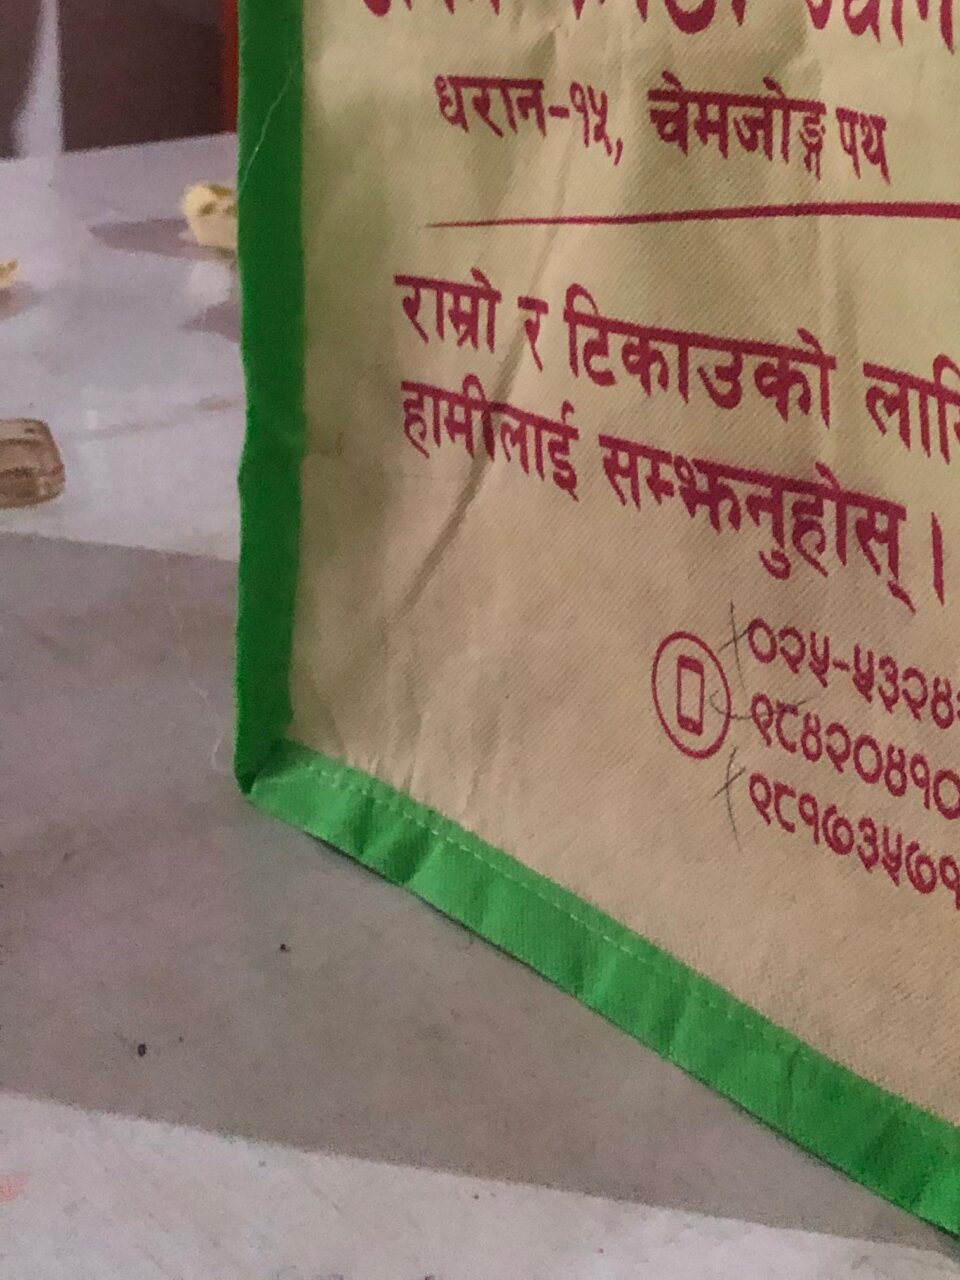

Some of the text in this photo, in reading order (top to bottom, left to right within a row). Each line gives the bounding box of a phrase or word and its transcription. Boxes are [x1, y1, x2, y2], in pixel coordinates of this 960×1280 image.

[434, 75, 623, 166] धरान-१५,
[835, 107, 892, 186] पथ
[394, 267, 502, 354] राम्रो
[518, 295, 549, 373] र
[562, 283, 837, 430] टिकाउको
[401, 373, 579, 502] हामीलाई
[598, 434, 915, 614] सम्झनुहोस्
